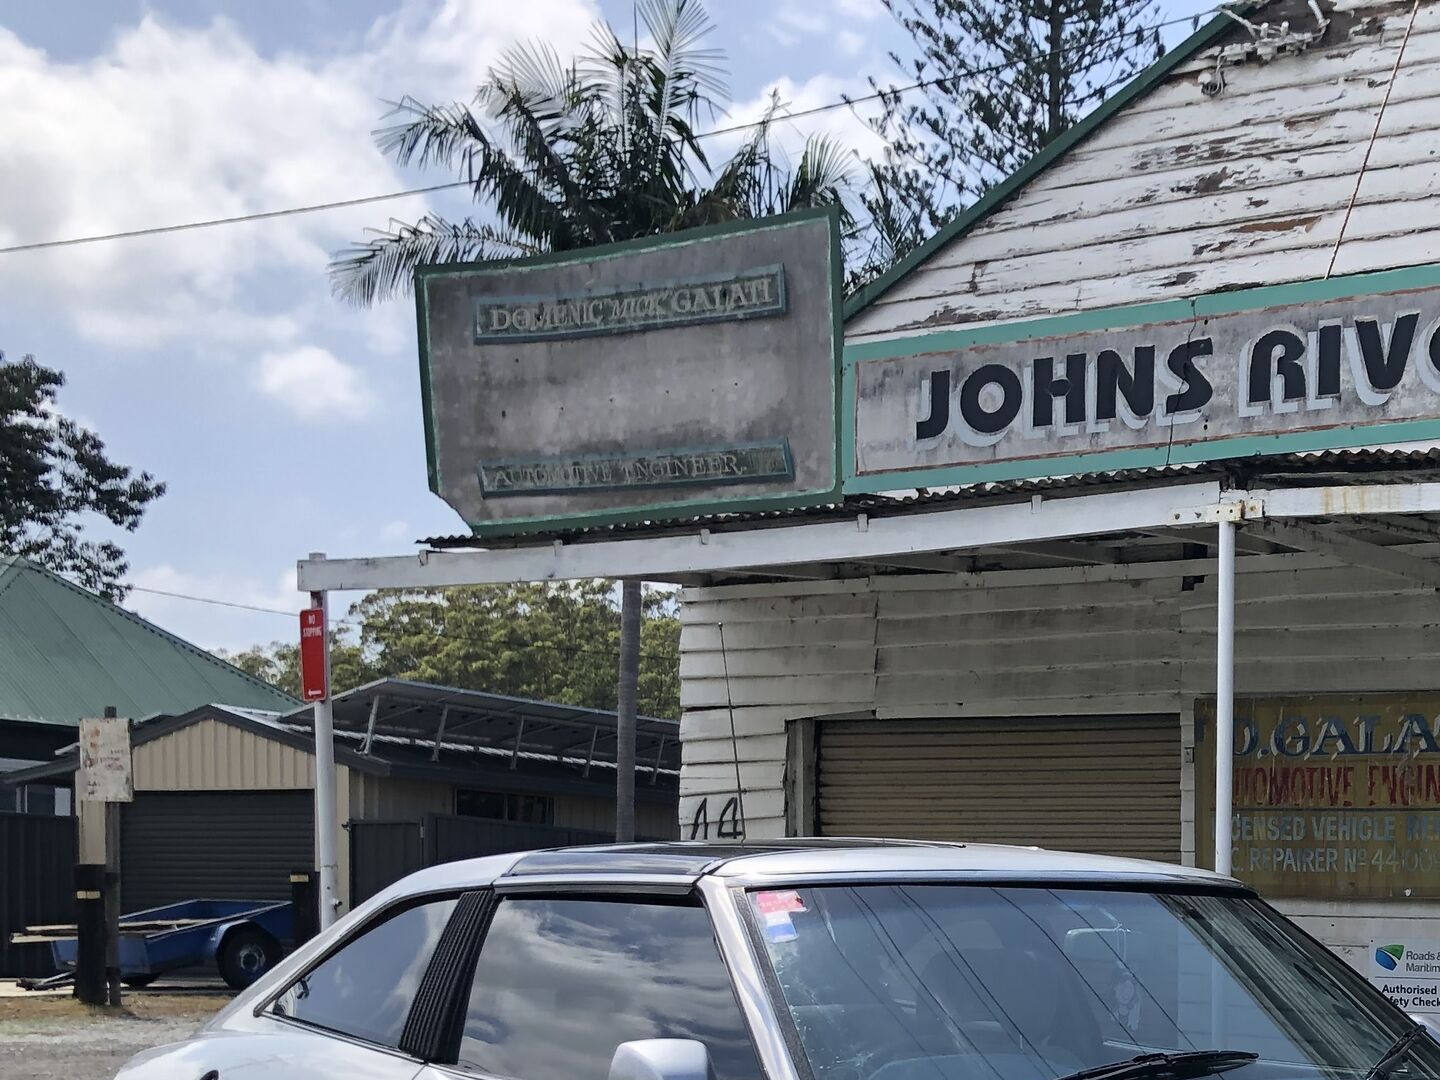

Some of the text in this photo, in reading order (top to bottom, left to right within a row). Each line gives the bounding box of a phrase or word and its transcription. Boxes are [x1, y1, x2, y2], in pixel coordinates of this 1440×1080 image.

[914, 336, 1213, 448] JOHNS
[1312, 815, 1395, 840] VEHICLE
[1250, 848, 1338, 873] REPAIRER
[1406, 950, 1435, 961] Roads
[1382, 984, 1438, 995] Authorised
[1389, 996, 1410, 1008] fety
